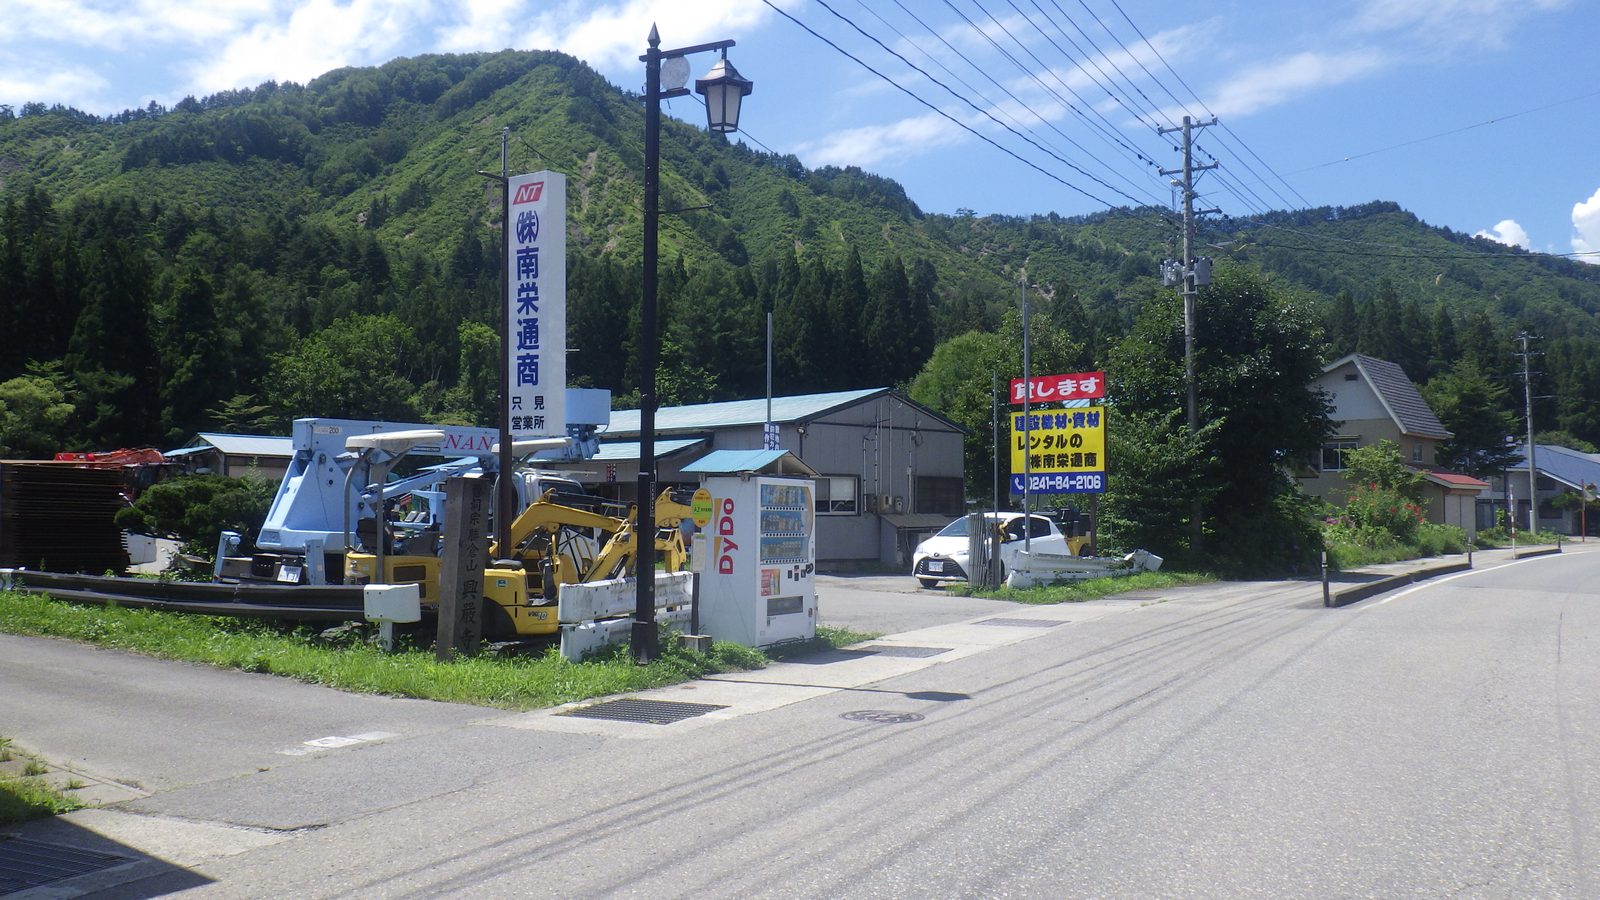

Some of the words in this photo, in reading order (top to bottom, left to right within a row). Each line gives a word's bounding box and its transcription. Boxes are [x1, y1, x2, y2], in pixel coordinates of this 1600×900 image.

[517, 184, 541, 202] NT
[1014, 377, 1100, 399] 貸します
[512, 415, 544, 430] 営業所
[1018, 434, 1083, 450] レンタルの
[719, 498, 738, 575] DyDo
